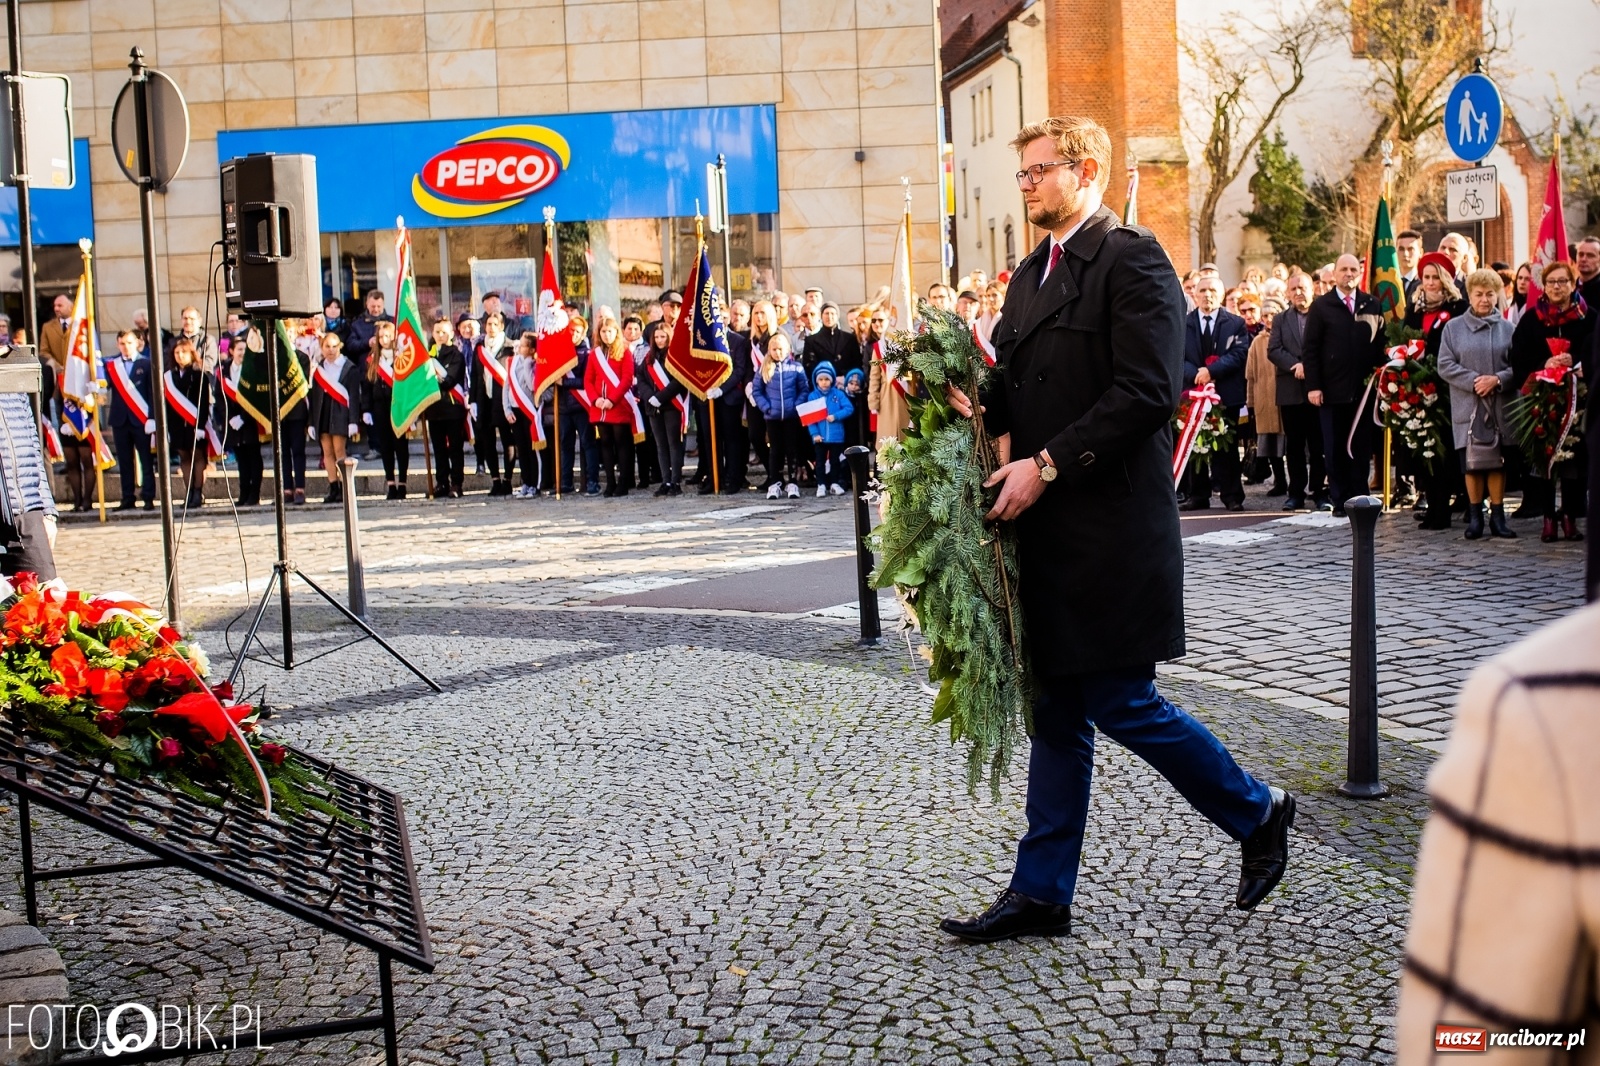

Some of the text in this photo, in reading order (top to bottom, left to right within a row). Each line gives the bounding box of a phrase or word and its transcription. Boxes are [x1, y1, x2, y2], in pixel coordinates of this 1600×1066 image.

[436, 155, 544, 188] PEPCO
[1449, 171, 1494, 185] Nie dotyczy
